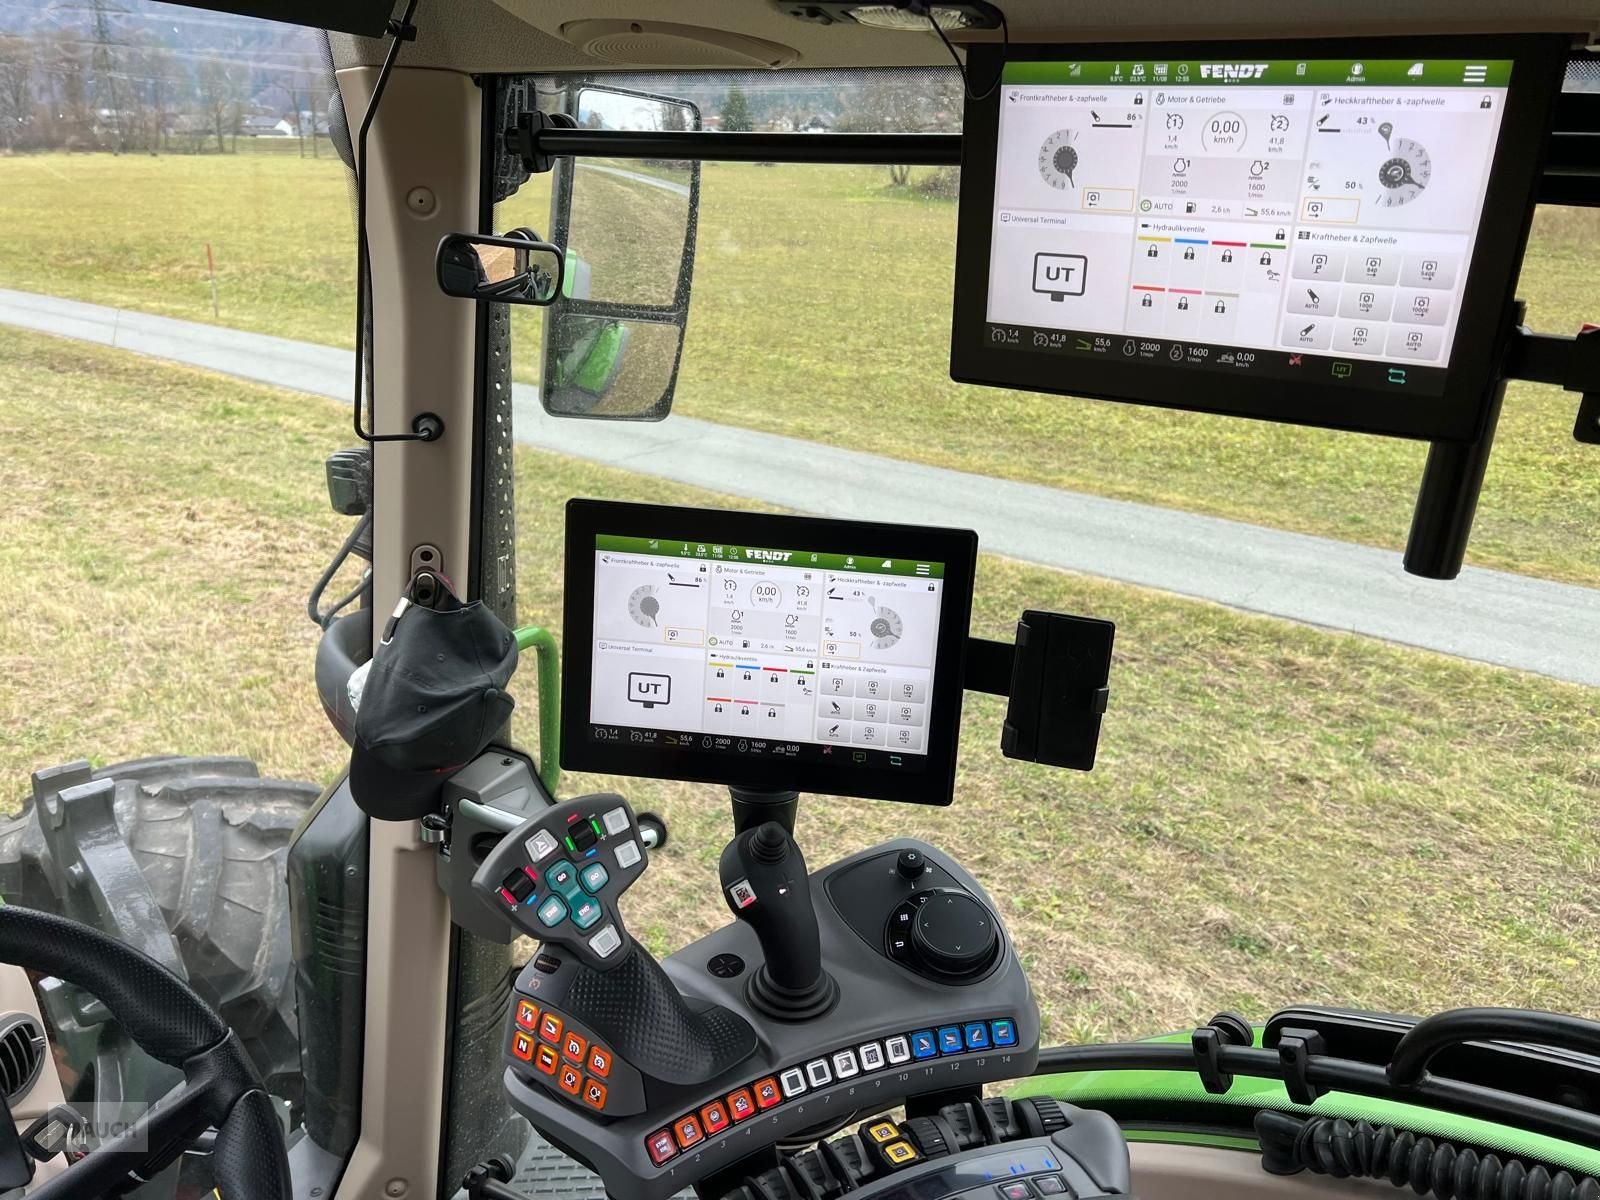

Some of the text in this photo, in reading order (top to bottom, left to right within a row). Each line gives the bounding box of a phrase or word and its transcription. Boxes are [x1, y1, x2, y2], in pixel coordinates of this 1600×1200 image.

[1200, 64, 1269, 78] FENDT
[1212, 121, 1240, 134] 0,00
[1214, 136, 1234, 144] km/h
[1261, 208, 1275, 216] 55,6
[1153, 223, 1205, 233] Hydraulikventile
[1312, 233, 1350, 242] Kraftheber
[1360, 236, 1397, 245] Zapfwelle
[1046, 266, 1075, 282] UT
[1009, 329, 1019, 338] 1,4
[1051, 334, 1066, 342] 41,8
[1095, 338, 1110, 347] 55,6
[1140, 342, 1160, 352] 2000
[1189, 348, 1208, 357] 1600
[1237, 352, 1255, 362] 0,00
[745, 549, 792, 561] FENDT
[756, 586, 776, 596] 0,00
[638, 682, 661, 694] UT
[518, 1040, 527, 1052] N
[695, 1154, 700, 1162] 2
[721, 1140, 726, 1148] 3
[951, 1063, 960, 1071] 12
